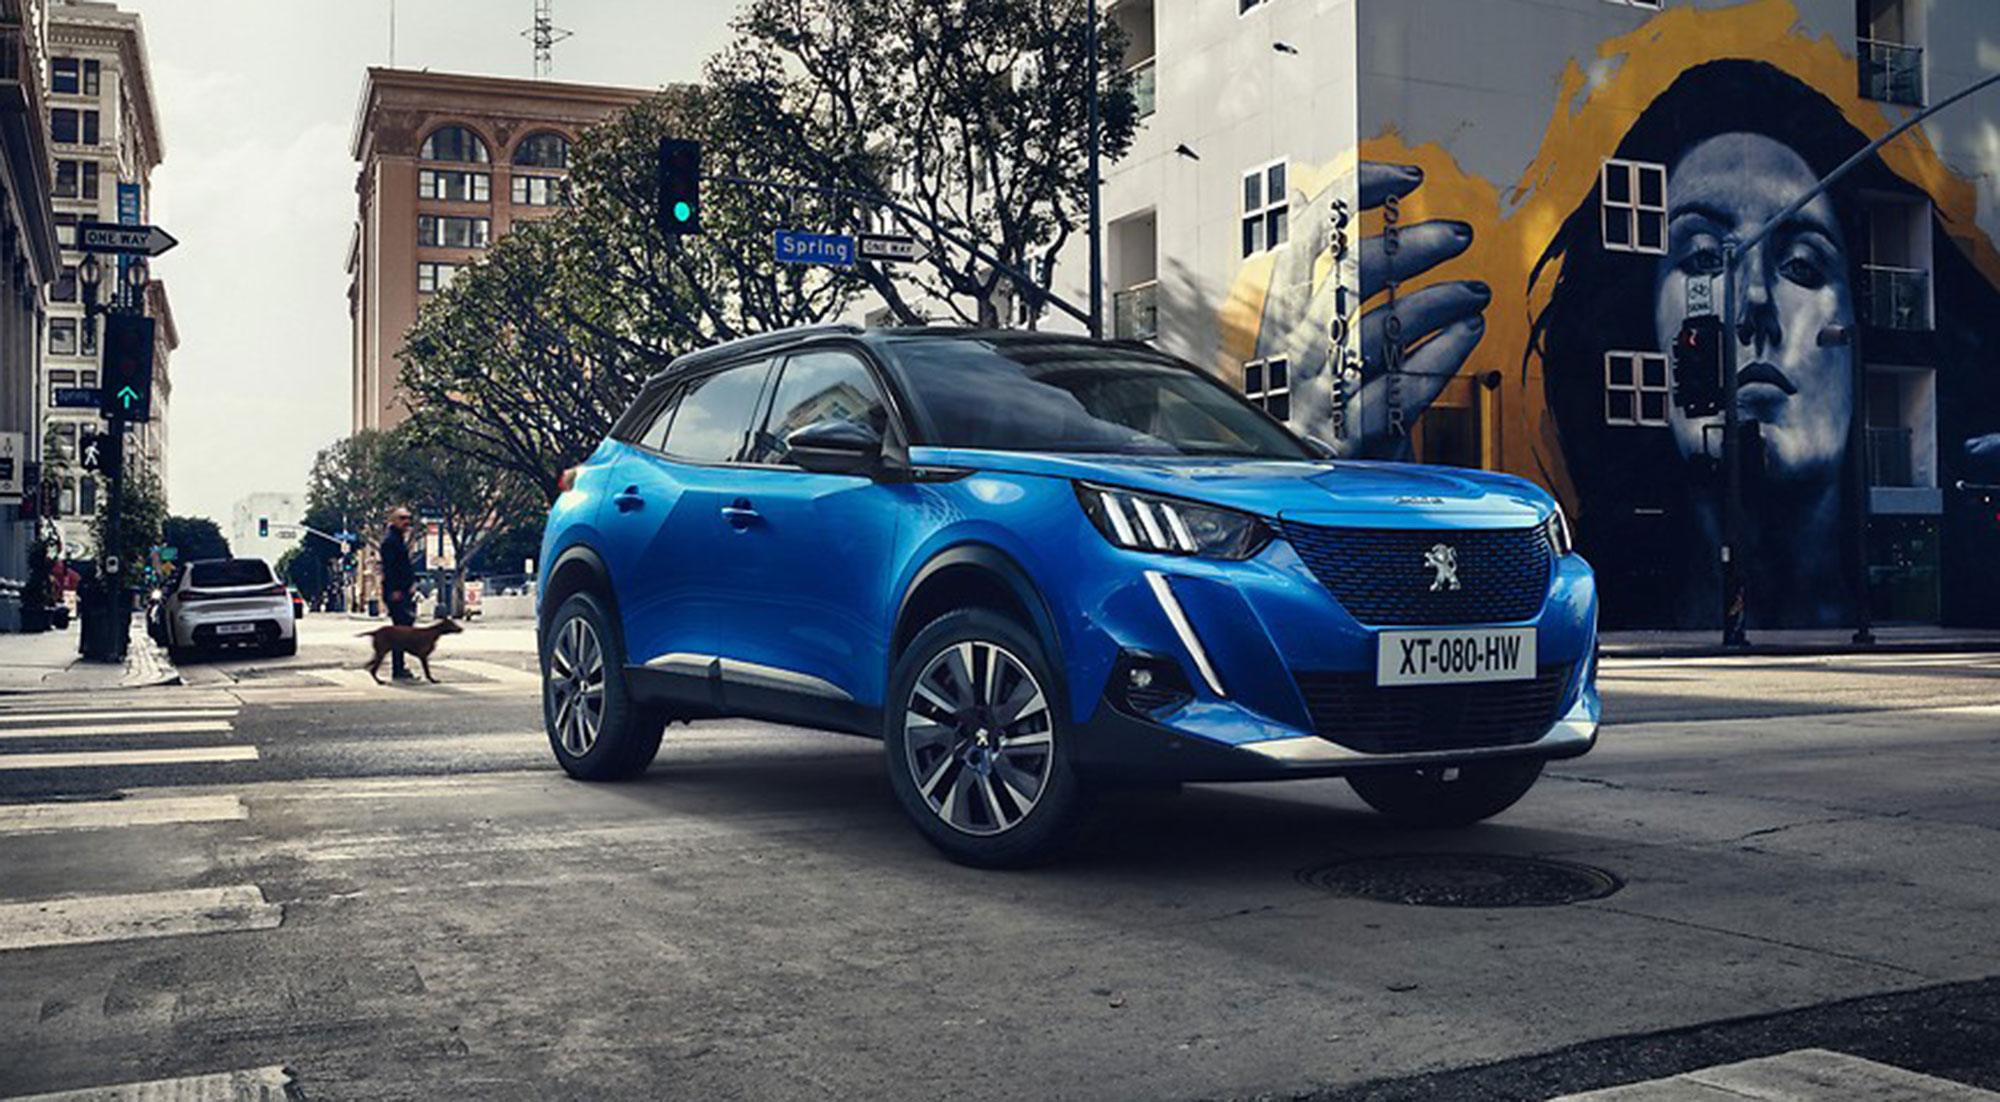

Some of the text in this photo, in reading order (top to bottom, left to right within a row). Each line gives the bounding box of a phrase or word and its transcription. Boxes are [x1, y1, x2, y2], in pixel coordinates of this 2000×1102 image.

[87, 230, 149, 246] ONE WAY
[783, 237, 848, 261] Spring
[864, 241, 912, 254] ONE WAY
[1384, 194, 1405, 437] SB TOWER
[1400, 635, 1521, 675] XT-080-HW
